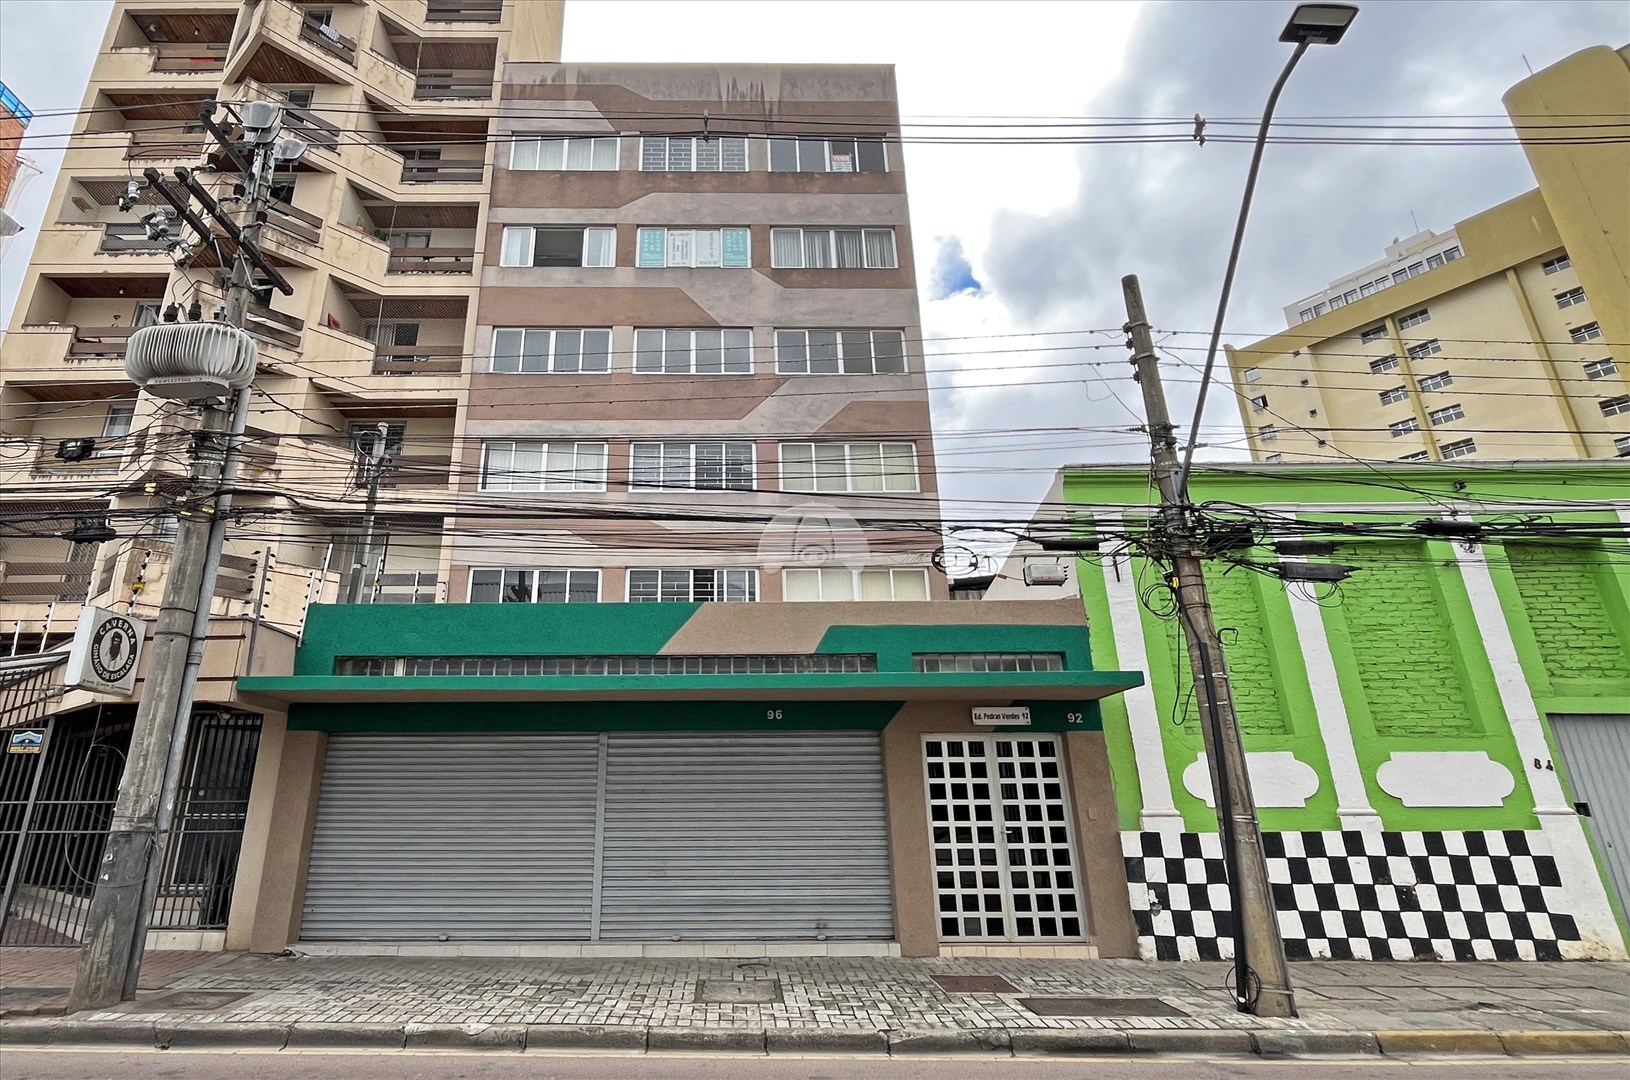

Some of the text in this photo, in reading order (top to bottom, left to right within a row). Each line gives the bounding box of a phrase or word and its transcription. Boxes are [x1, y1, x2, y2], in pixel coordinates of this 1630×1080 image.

[99, 619, 136, 645] CAVERNA
[102, 671, 111, 680] DE
[110, 654, 135, 680] ESCALADA
[767, 709, 783, 720] 96
[974, 712, 1029, 720] Ed. Pedras Verdes 92
[1067, 713, 1083, 723] 92
